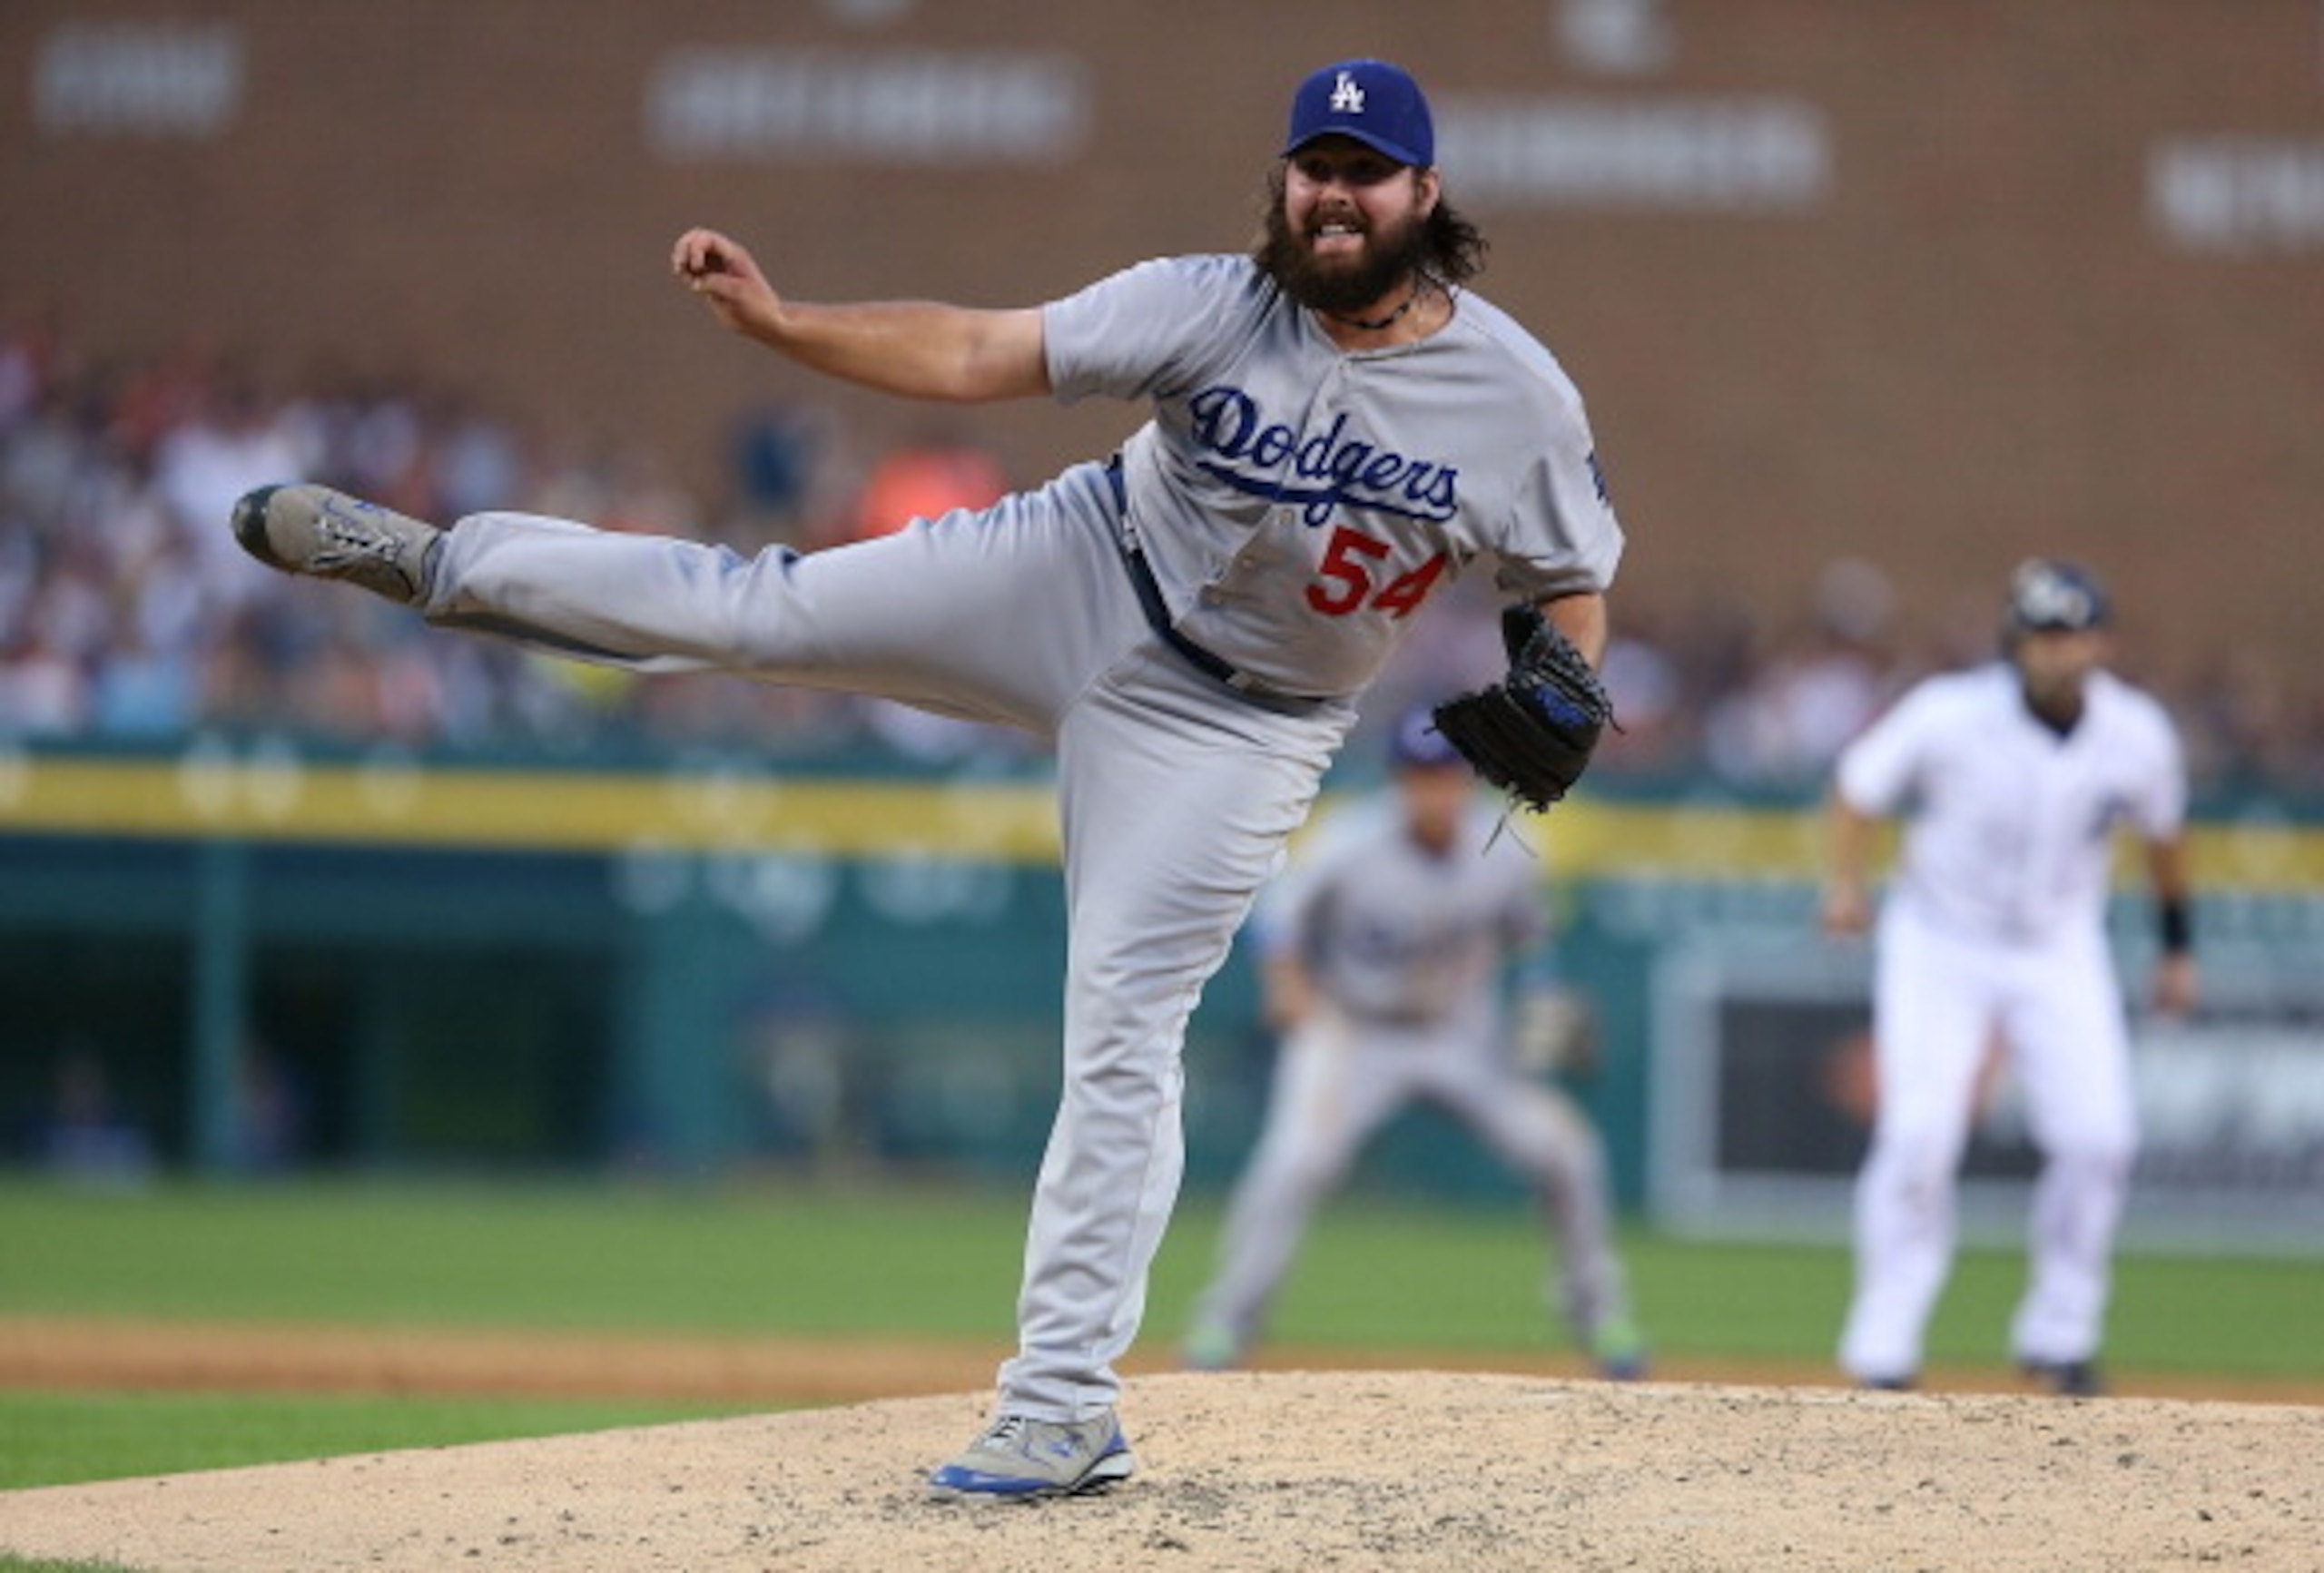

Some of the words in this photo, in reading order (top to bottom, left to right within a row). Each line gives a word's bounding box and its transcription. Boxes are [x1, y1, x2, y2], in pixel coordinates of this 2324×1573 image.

[1329, 71, 1364, 113] LA
[1190, 387, 1459, 526] Dodgers
[1305, 526, 1450, 620] 54
